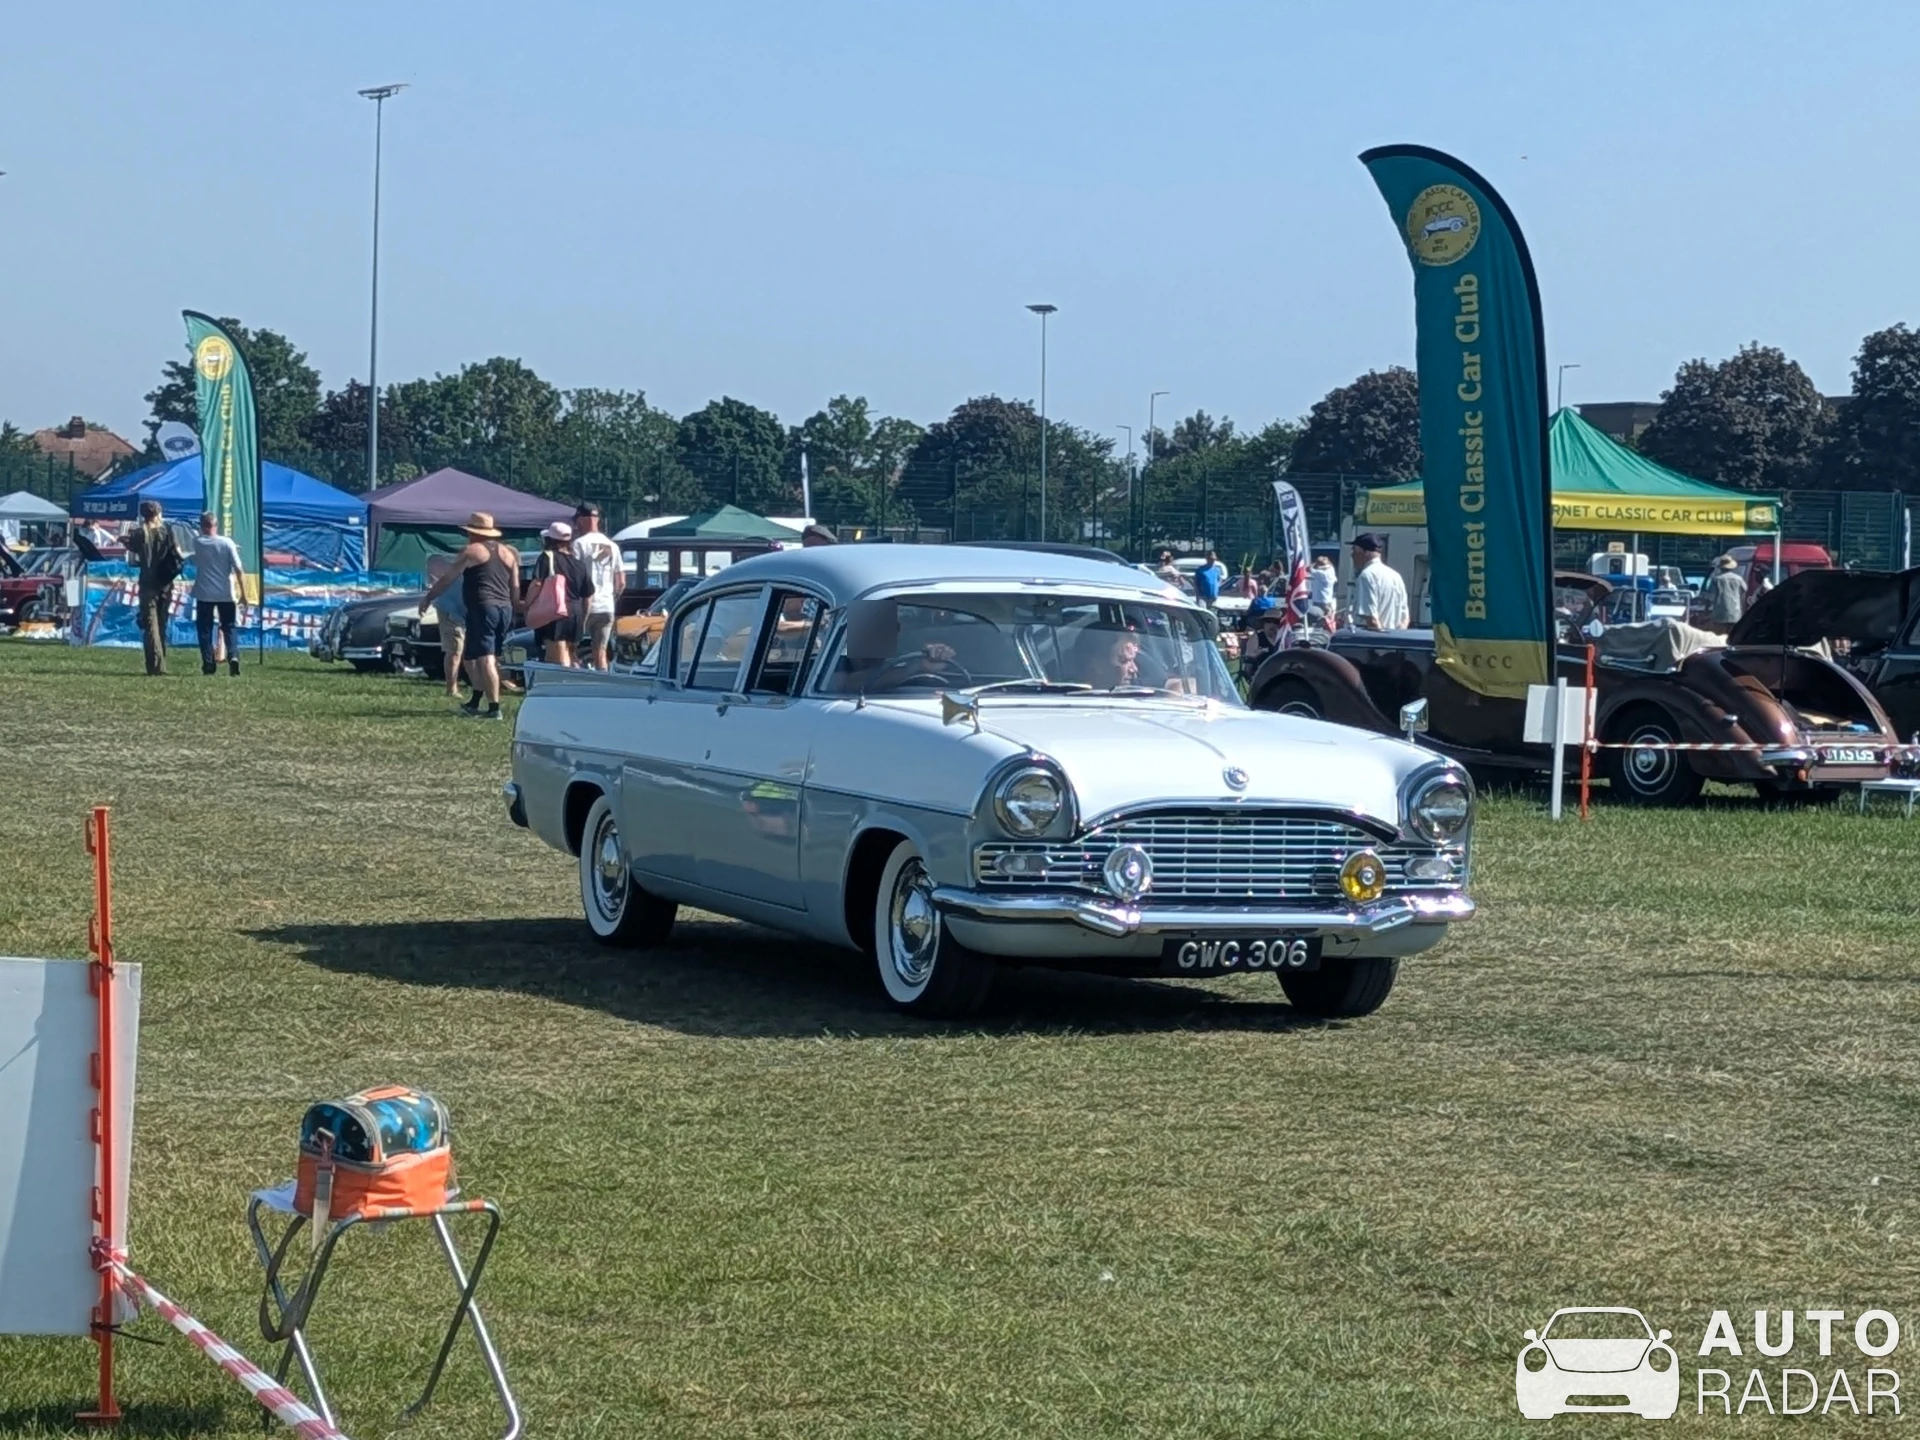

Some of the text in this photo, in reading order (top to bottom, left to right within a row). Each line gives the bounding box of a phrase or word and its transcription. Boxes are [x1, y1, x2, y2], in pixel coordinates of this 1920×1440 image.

[1453, 273, 1486, 620] Barnet Classic Car Club
[1595, 506, 1657, 521] CLASSIC
[1661, 508, 1691, 522] CAR
[1695, 510, 1734, 523] CLUB
[1178, 940, 1308, 968] GWC 306
